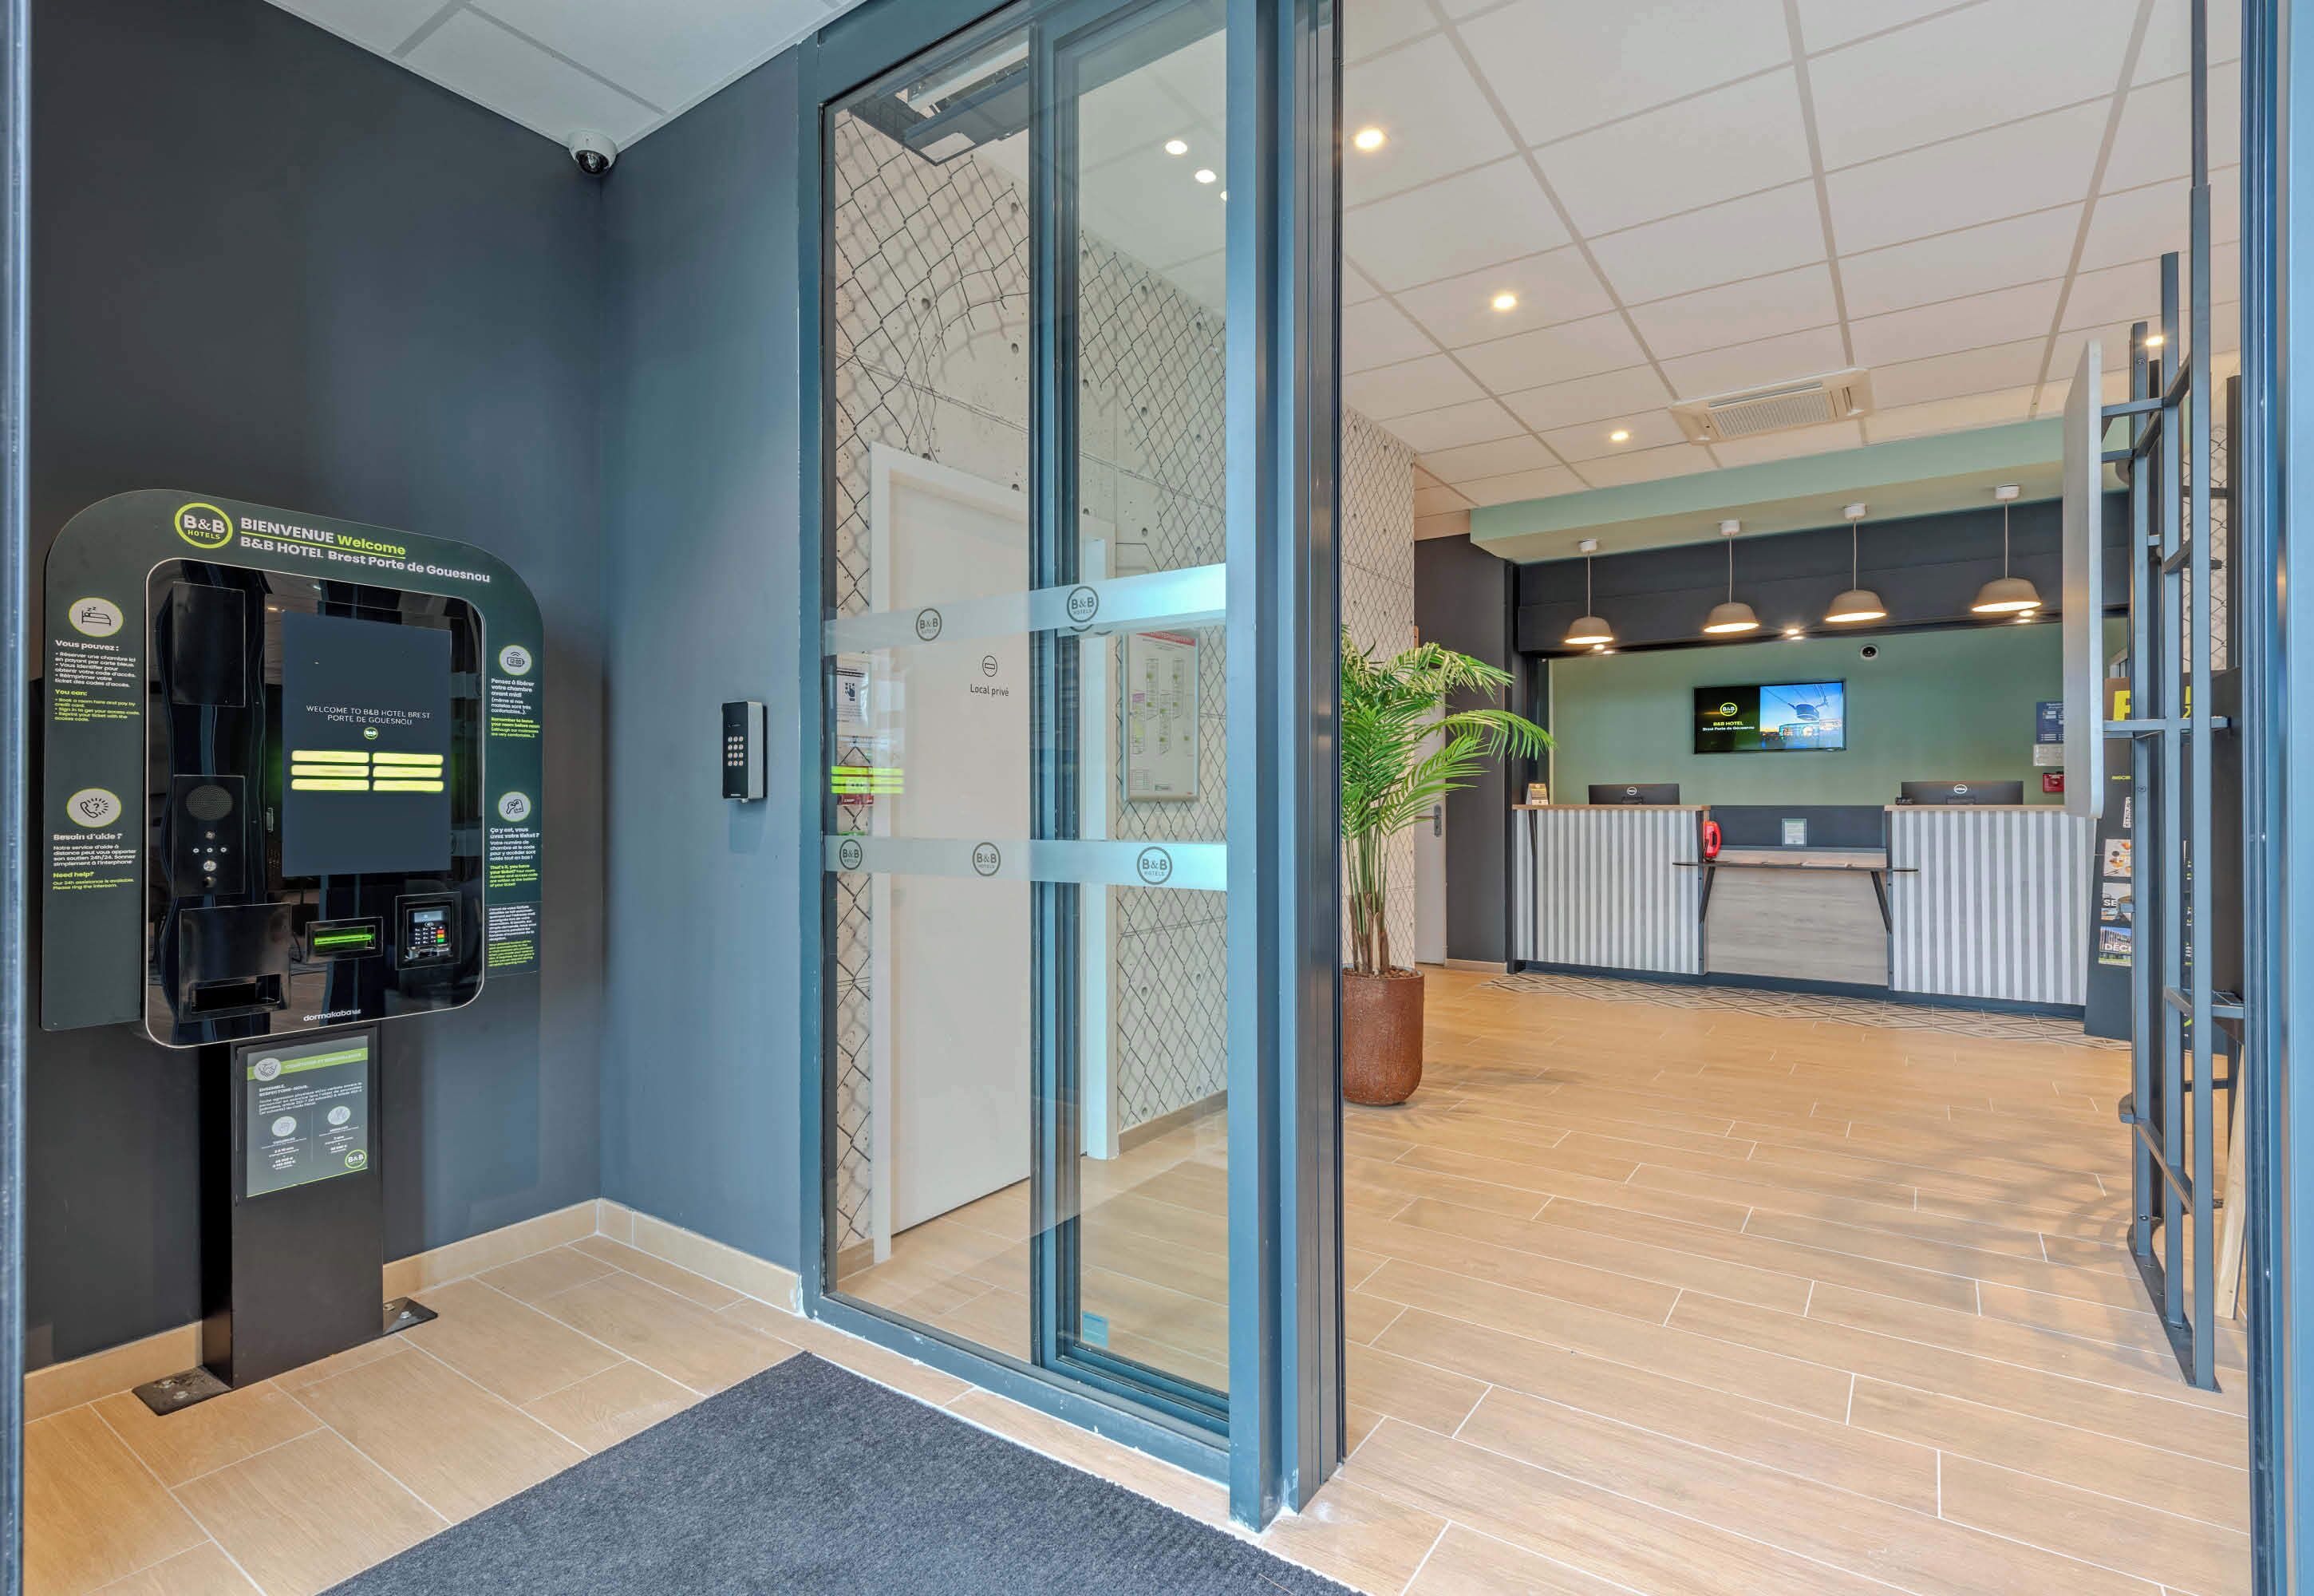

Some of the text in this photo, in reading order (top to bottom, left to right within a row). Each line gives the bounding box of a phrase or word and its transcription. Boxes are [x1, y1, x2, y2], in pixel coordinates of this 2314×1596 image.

[184, 515, 225, 534] B&B
[188, 529, 220, 540] HOTELS
[241, 517, 405, 555] BIENVENUE Welcome
[241, 536, 490, 583] B&B HOTEL Brest Porte de Gouesnou
[1072, 598, 1093, 609] B&B
[920, 618, 938, 629] B&B
[969, 684, 1009, 697] Local privé
[306, 705, 347, 713] WELCOME
[843, 849, 859, 858] B&B
[977, 853, 997, 863] B&B
[1143, 859, 1167, 870] B&B
[303, 1009, 351, 1021] dormakaba
